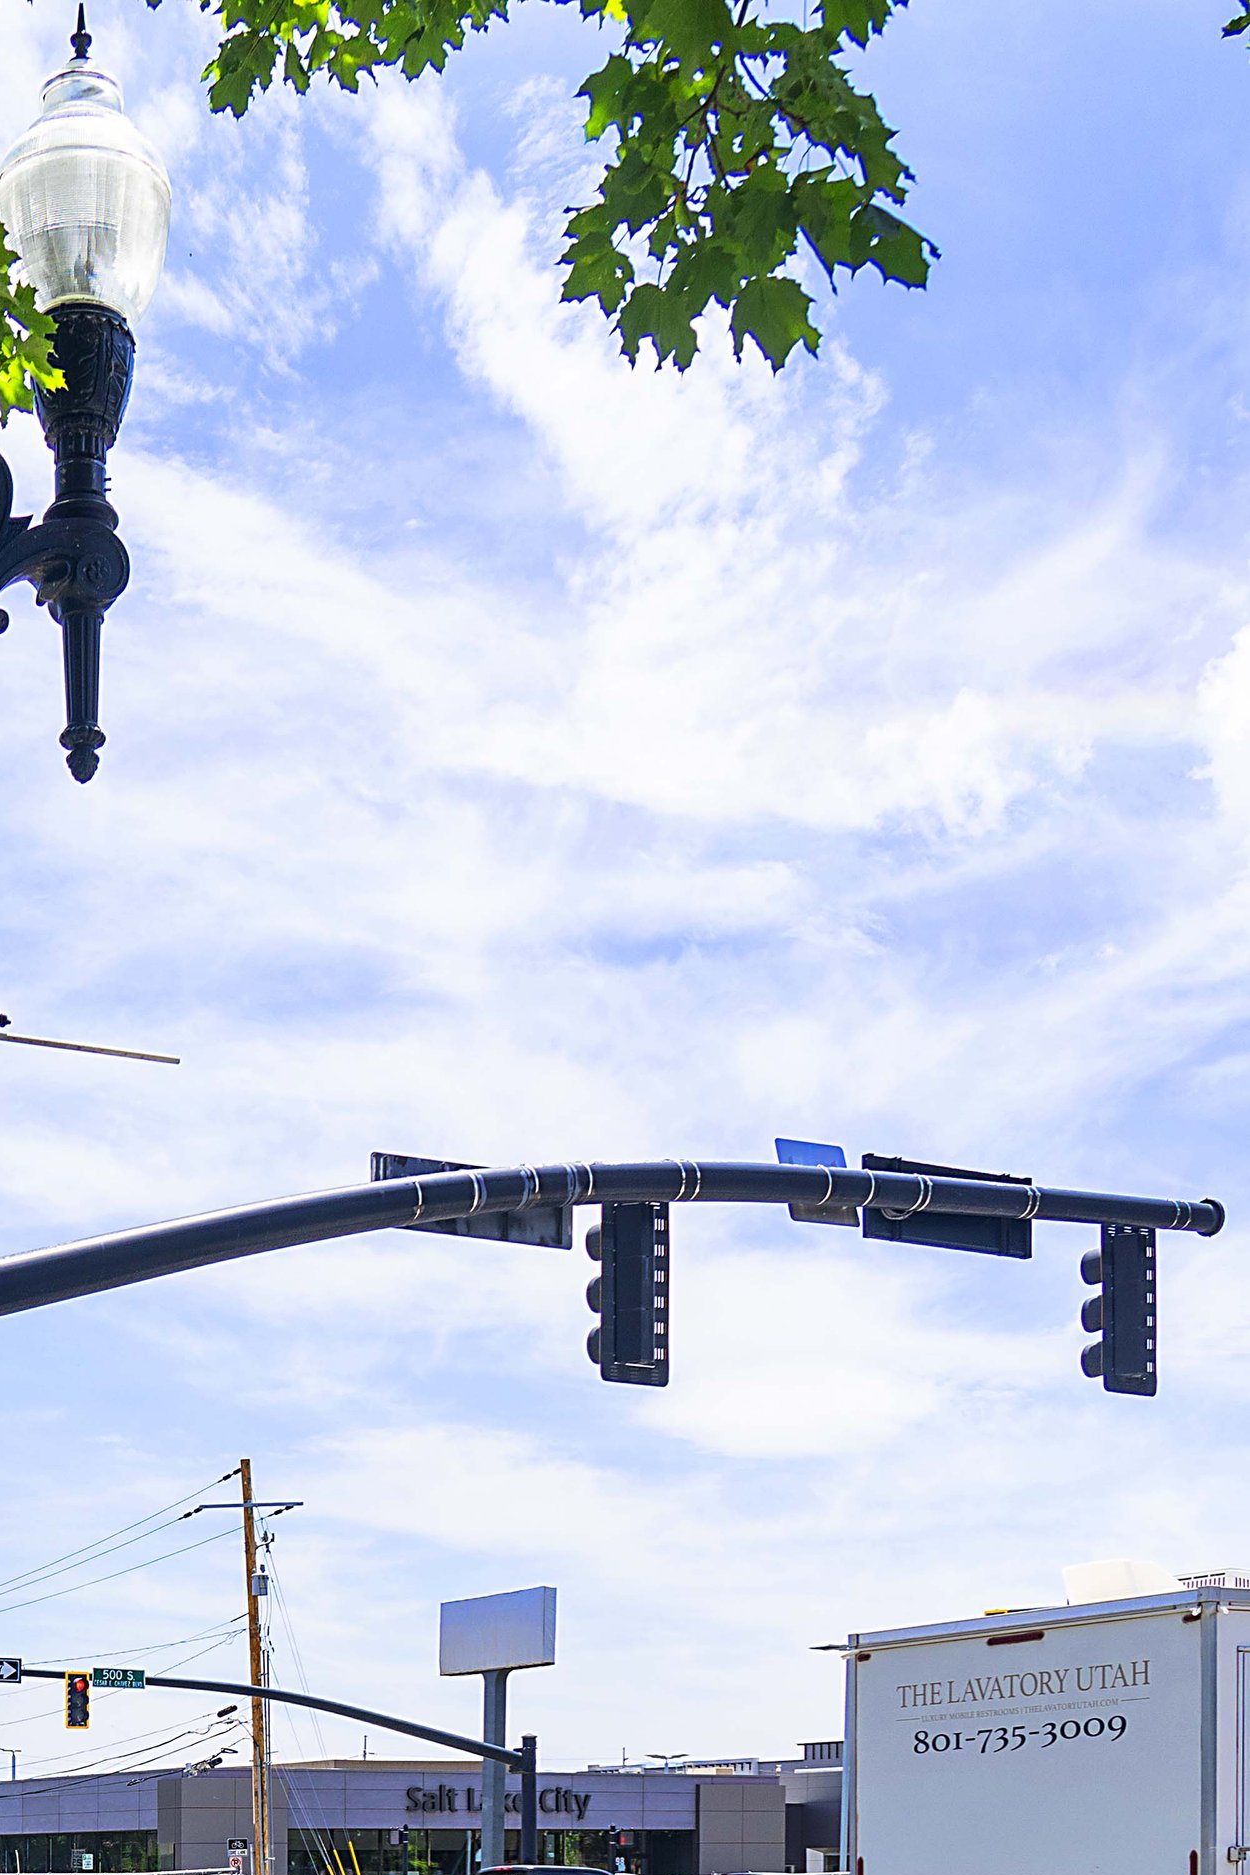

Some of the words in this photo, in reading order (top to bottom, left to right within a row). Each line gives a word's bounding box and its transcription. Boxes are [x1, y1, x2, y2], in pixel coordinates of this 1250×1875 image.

[102, 1669, 123, 1680] 500
[896, 1682, 943, 1708] THE
[947, 1669, 1070, 1704] LAVATORY
[1075, 1660, 1150, 1692] UTAH
[921, 1713, 948, 1722] LUXURY
[949, 1711, 975, 1721] MOBILE
[976, 1707, 1020, 1718] RESTROOMS
[1024, 1698, 1119, 1714] THELAVATORYUTAH.COM
[913, 1715, 1127, 1754] 801-735-3009
[405, 1784, 458, 1813] Salt
[538, 1786, 592, 1821] City
